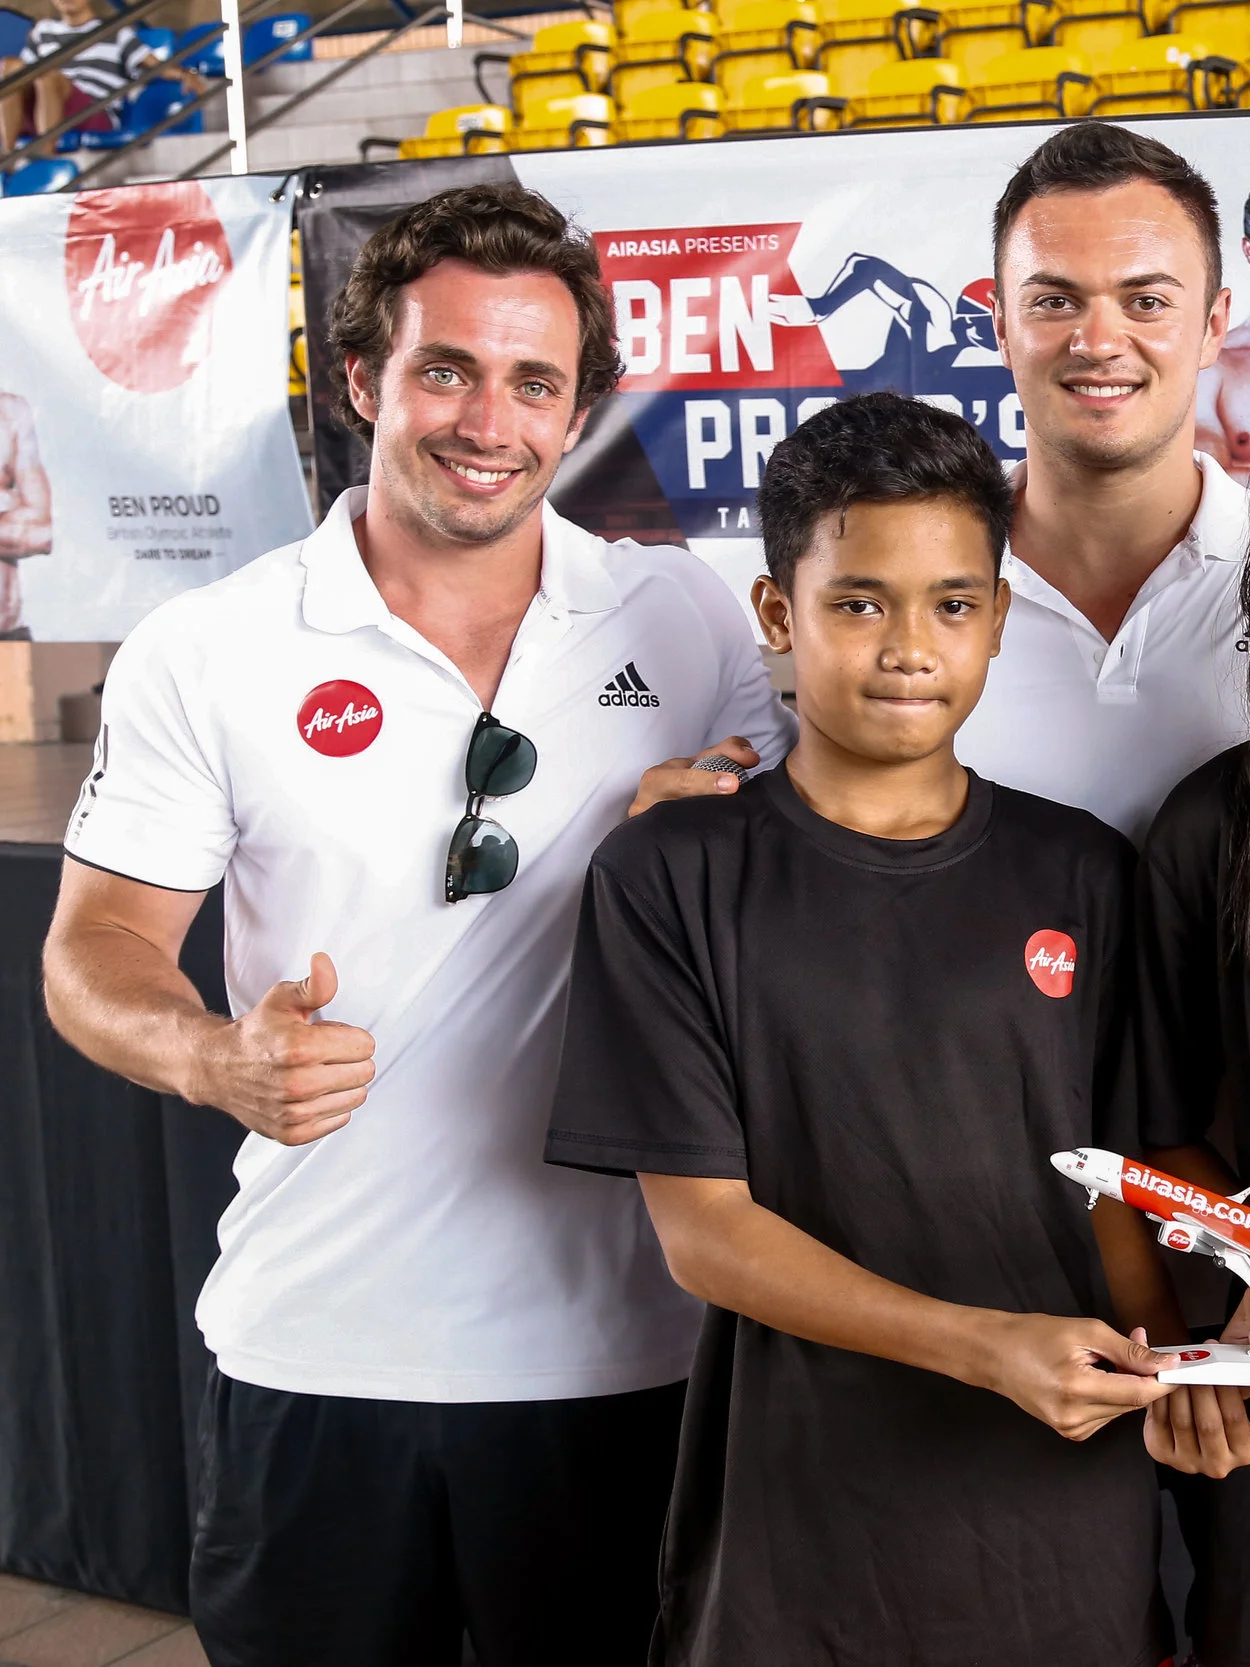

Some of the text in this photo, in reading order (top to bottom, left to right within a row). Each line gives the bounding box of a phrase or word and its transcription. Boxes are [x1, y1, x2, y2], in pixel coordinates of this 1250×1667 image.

[607, 234, 780, 257] AIRASIA PRESENTS
[612, 274, 774, 375] BEN
[108, 494, 220, 517] BEN PROUD
[598, 690, 660, 708] adidas
